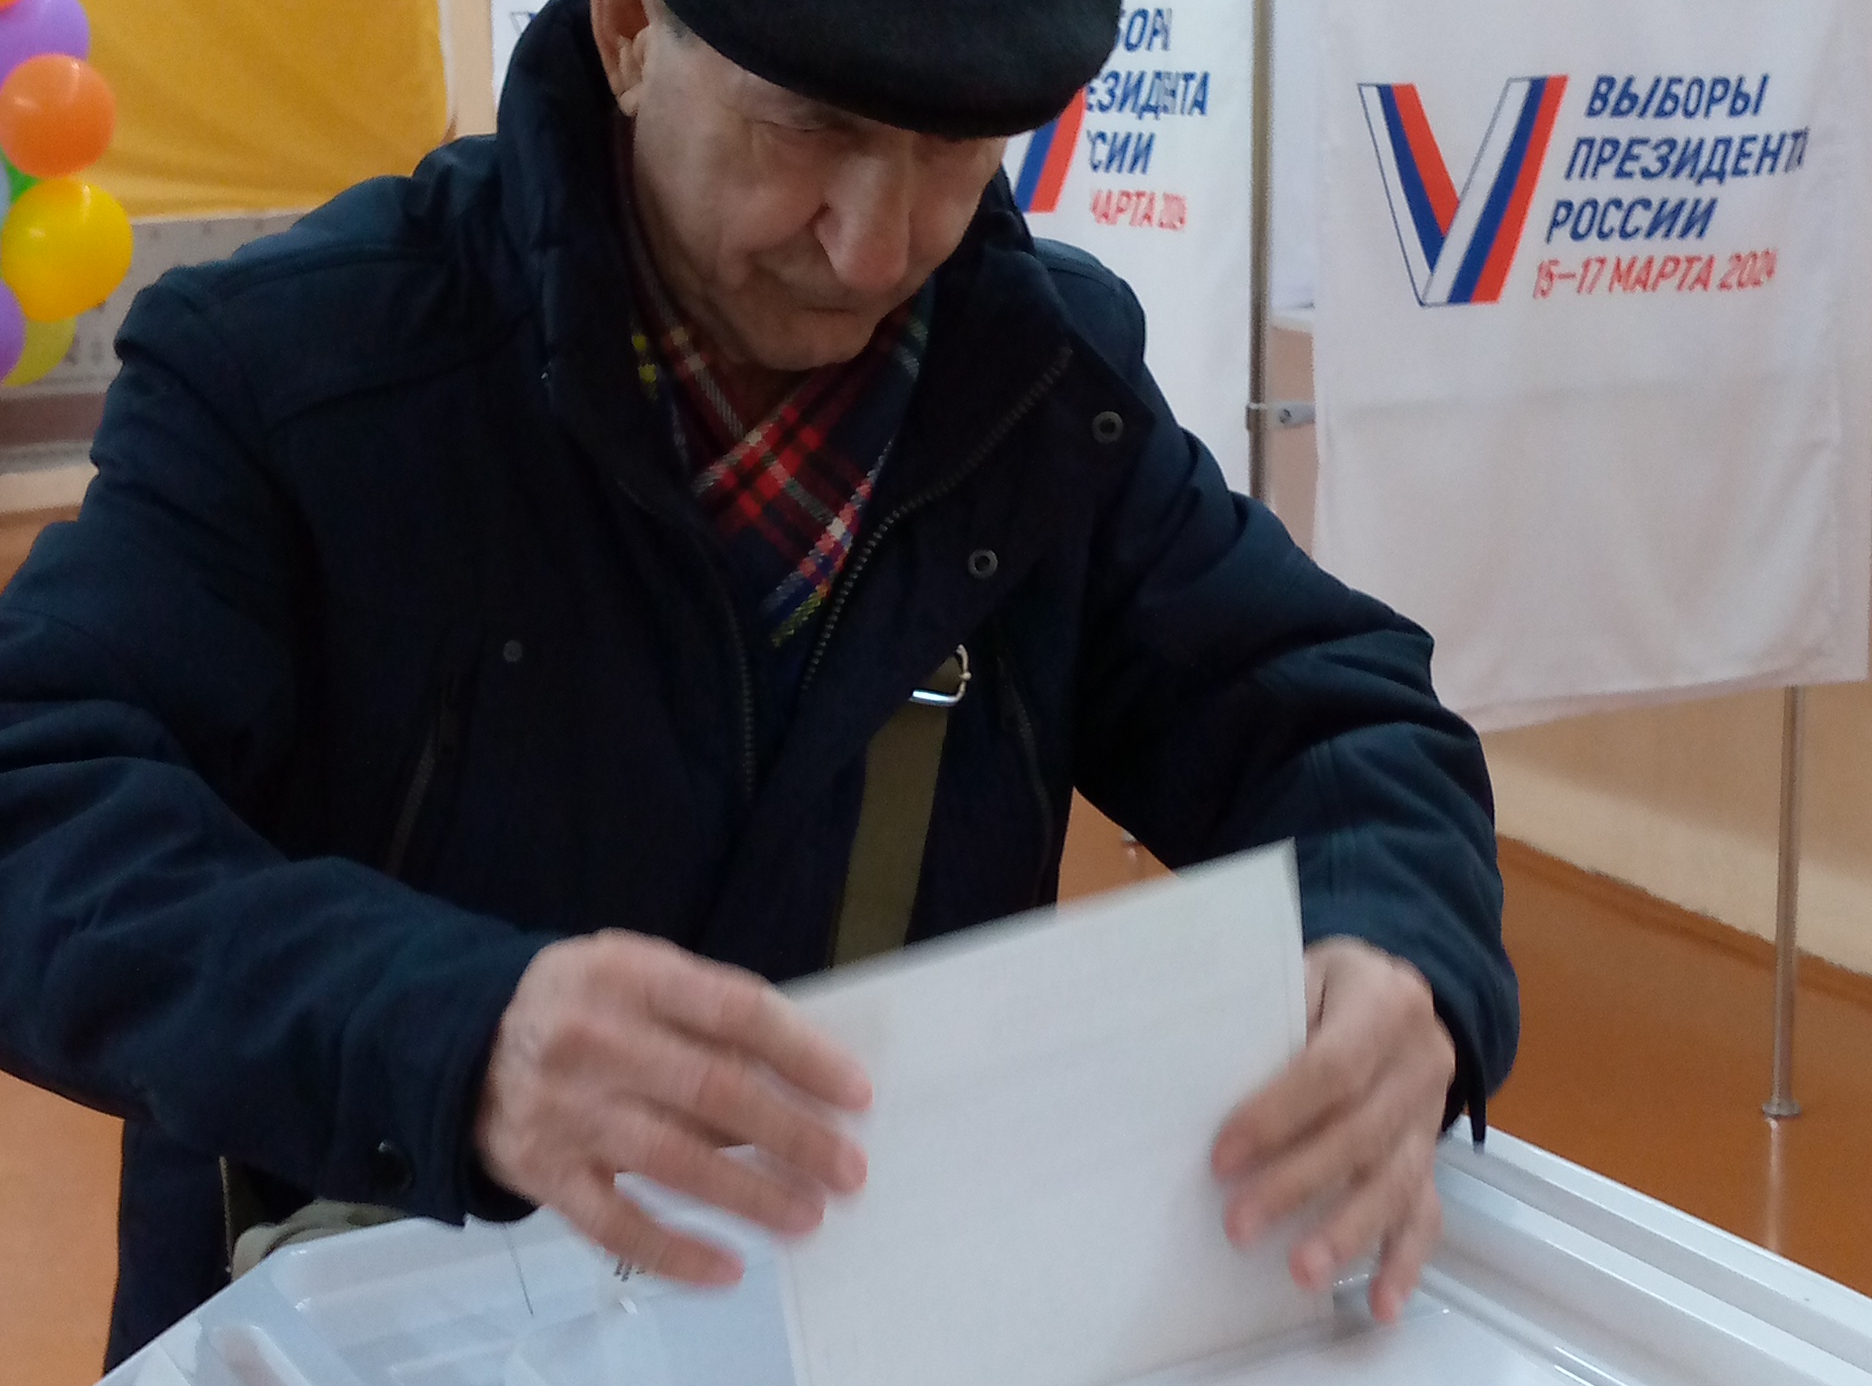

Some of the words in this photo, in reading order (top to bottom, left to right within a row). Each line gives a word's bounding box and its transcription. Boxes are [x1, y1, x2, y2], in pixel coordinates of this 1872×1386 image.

[1584, 73, 1770, 119] ВЫБОРЫ
[1546, 196, 1719, 244] РОССИИ
[1607, 253, 1716, 294] МАРТА
